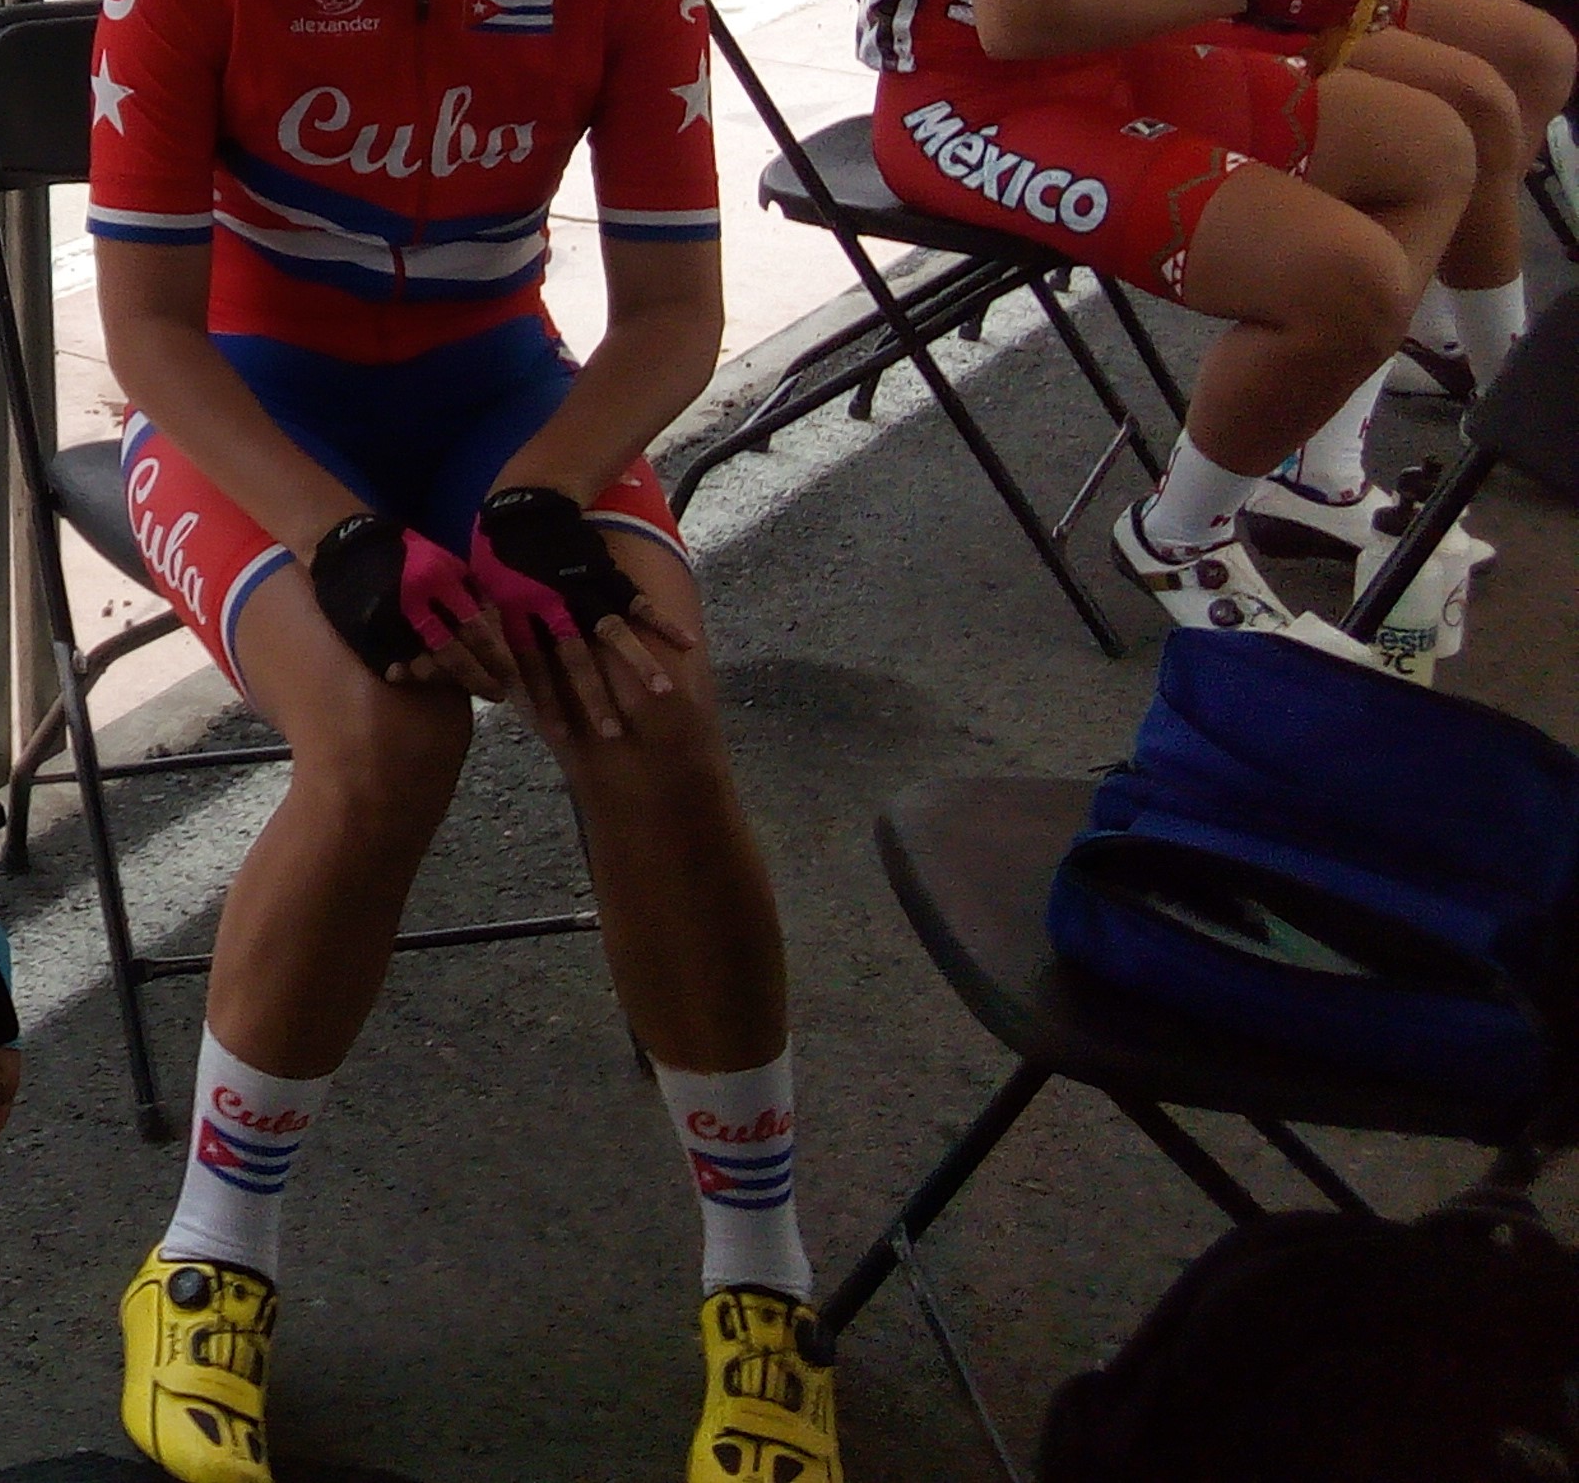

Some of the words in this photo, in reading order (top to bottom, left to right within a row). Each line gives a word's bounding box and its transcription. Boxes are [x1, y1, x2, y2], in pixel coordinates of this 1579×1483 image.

[289, 13, 381, 34] alexander
[277, 84, 538, 189] Cuba
[128, 456, 207, 626] Cuba
[210, 1084, 311, 1135] Cuba
